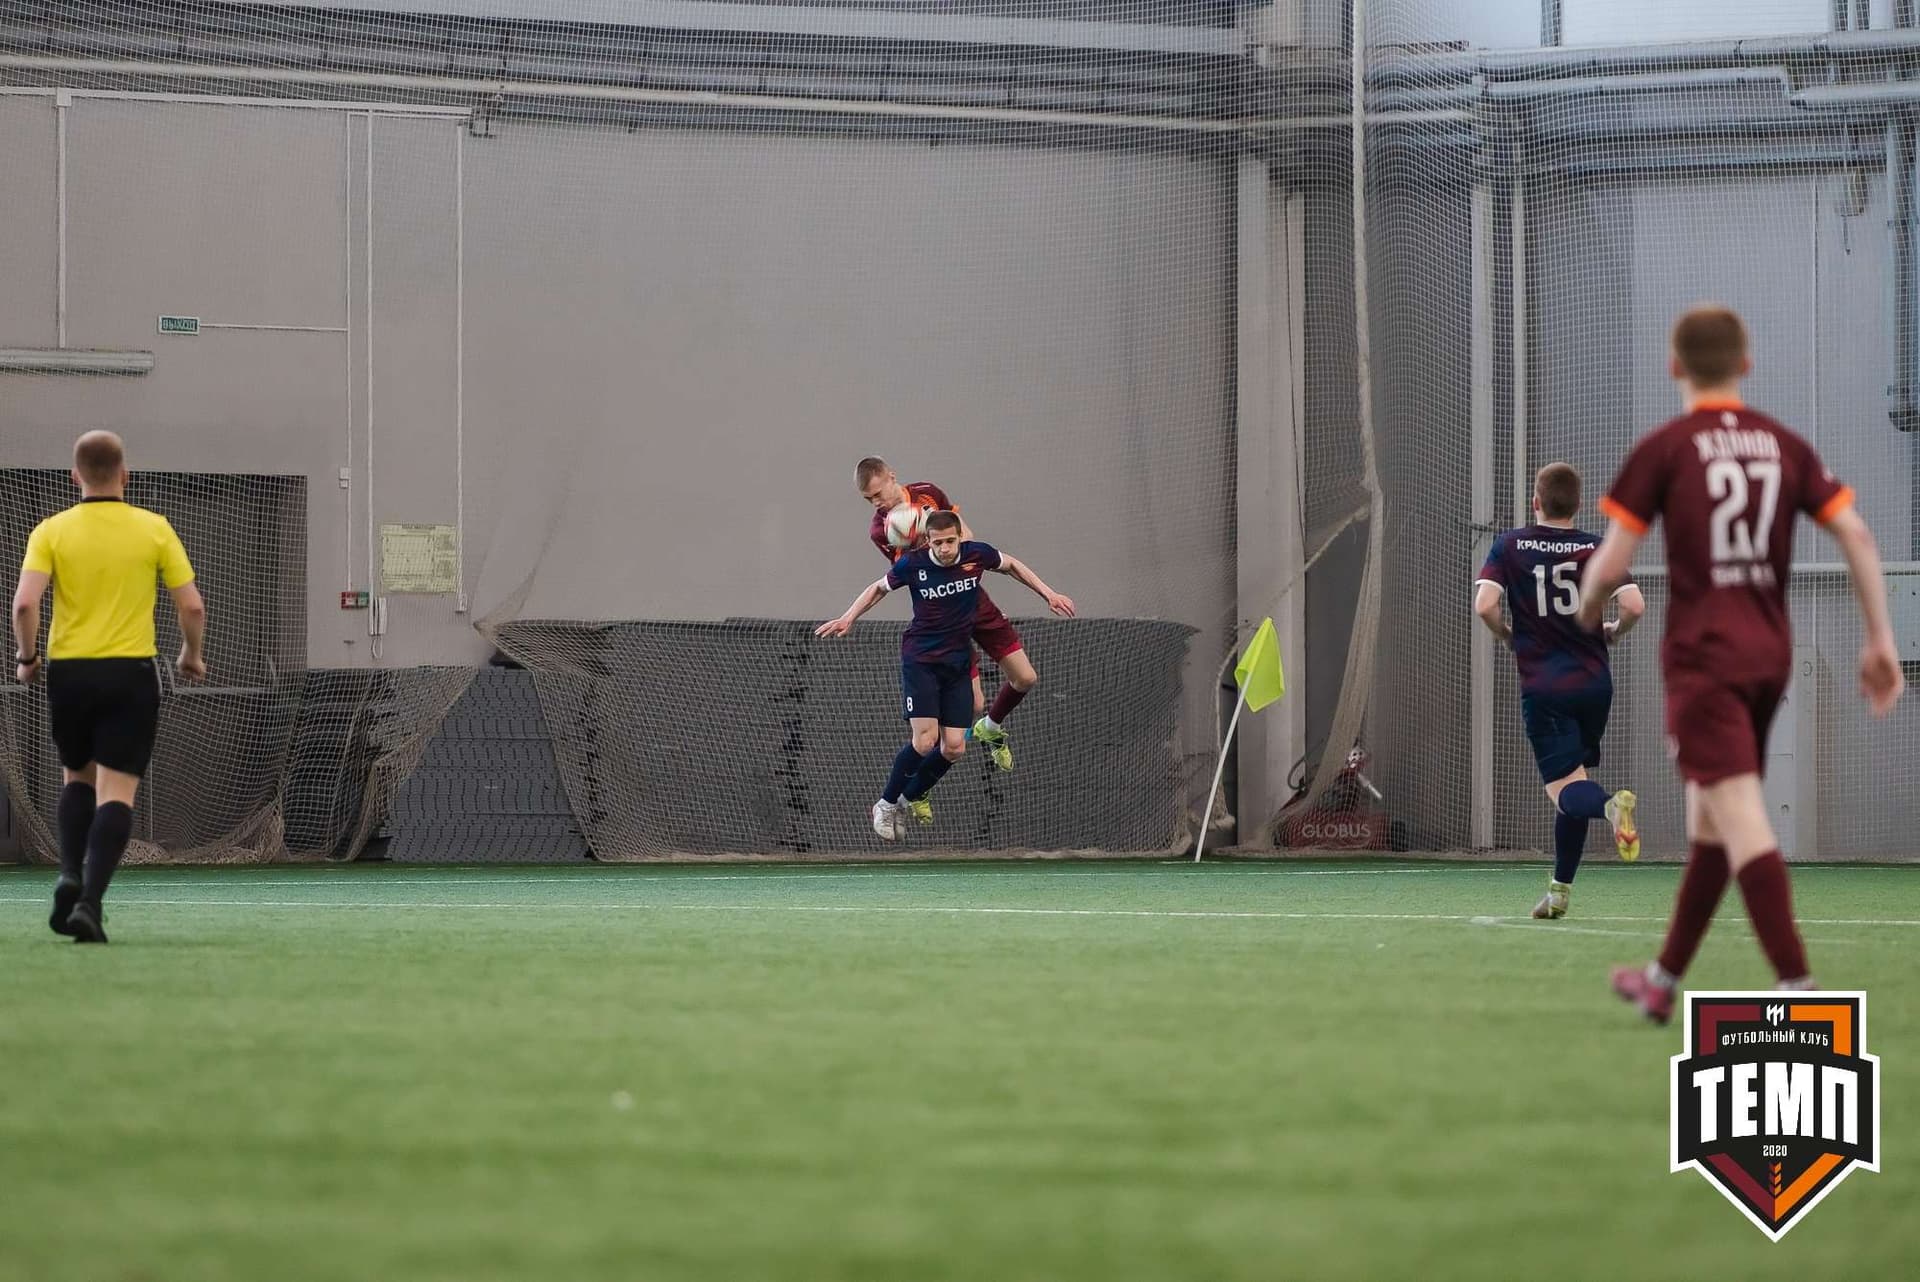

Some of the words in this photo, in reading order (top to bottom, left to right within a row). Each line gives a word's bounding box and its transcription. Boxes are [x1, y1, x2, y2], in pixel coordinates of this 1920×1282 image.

[1706, 459, 1782, 562] 27
[919, 569, 928, 581] 8
[920, 576, 977, 599] РАССВЕТ
[1532, 561, 1579, 617] 15
[907, 696, 913, 712] 8
[1301, 823, 1371, 839] GLOBUS
